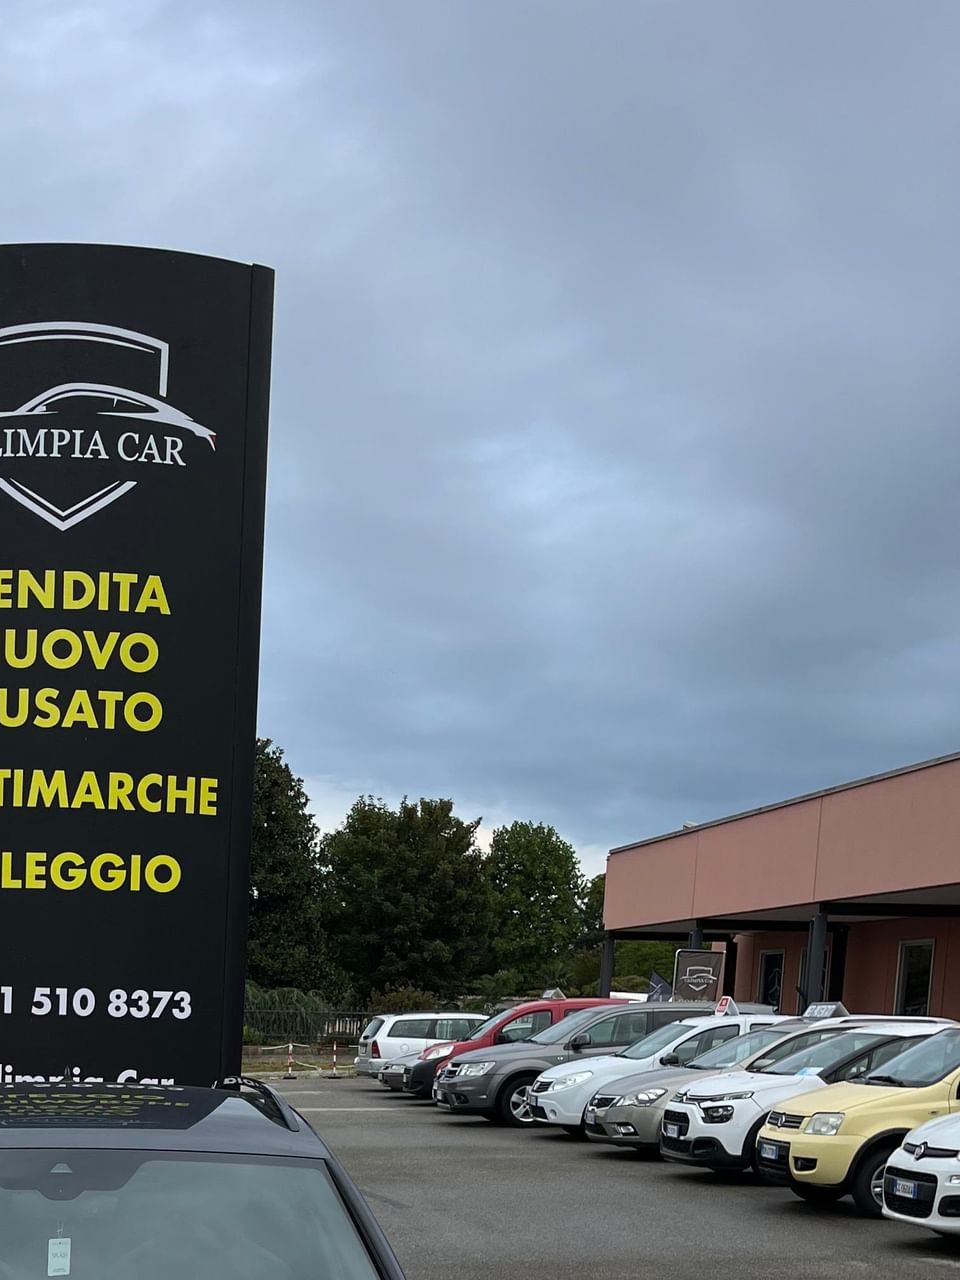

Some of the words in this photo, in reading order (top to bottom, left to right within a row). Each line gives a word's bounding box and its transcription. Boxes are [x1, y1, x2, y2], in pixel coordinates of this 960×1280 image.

[117, 432, 186, 466] CAR
[31, 987, 96, 1017] 510
[107, 989, 192, 1020] 8373
